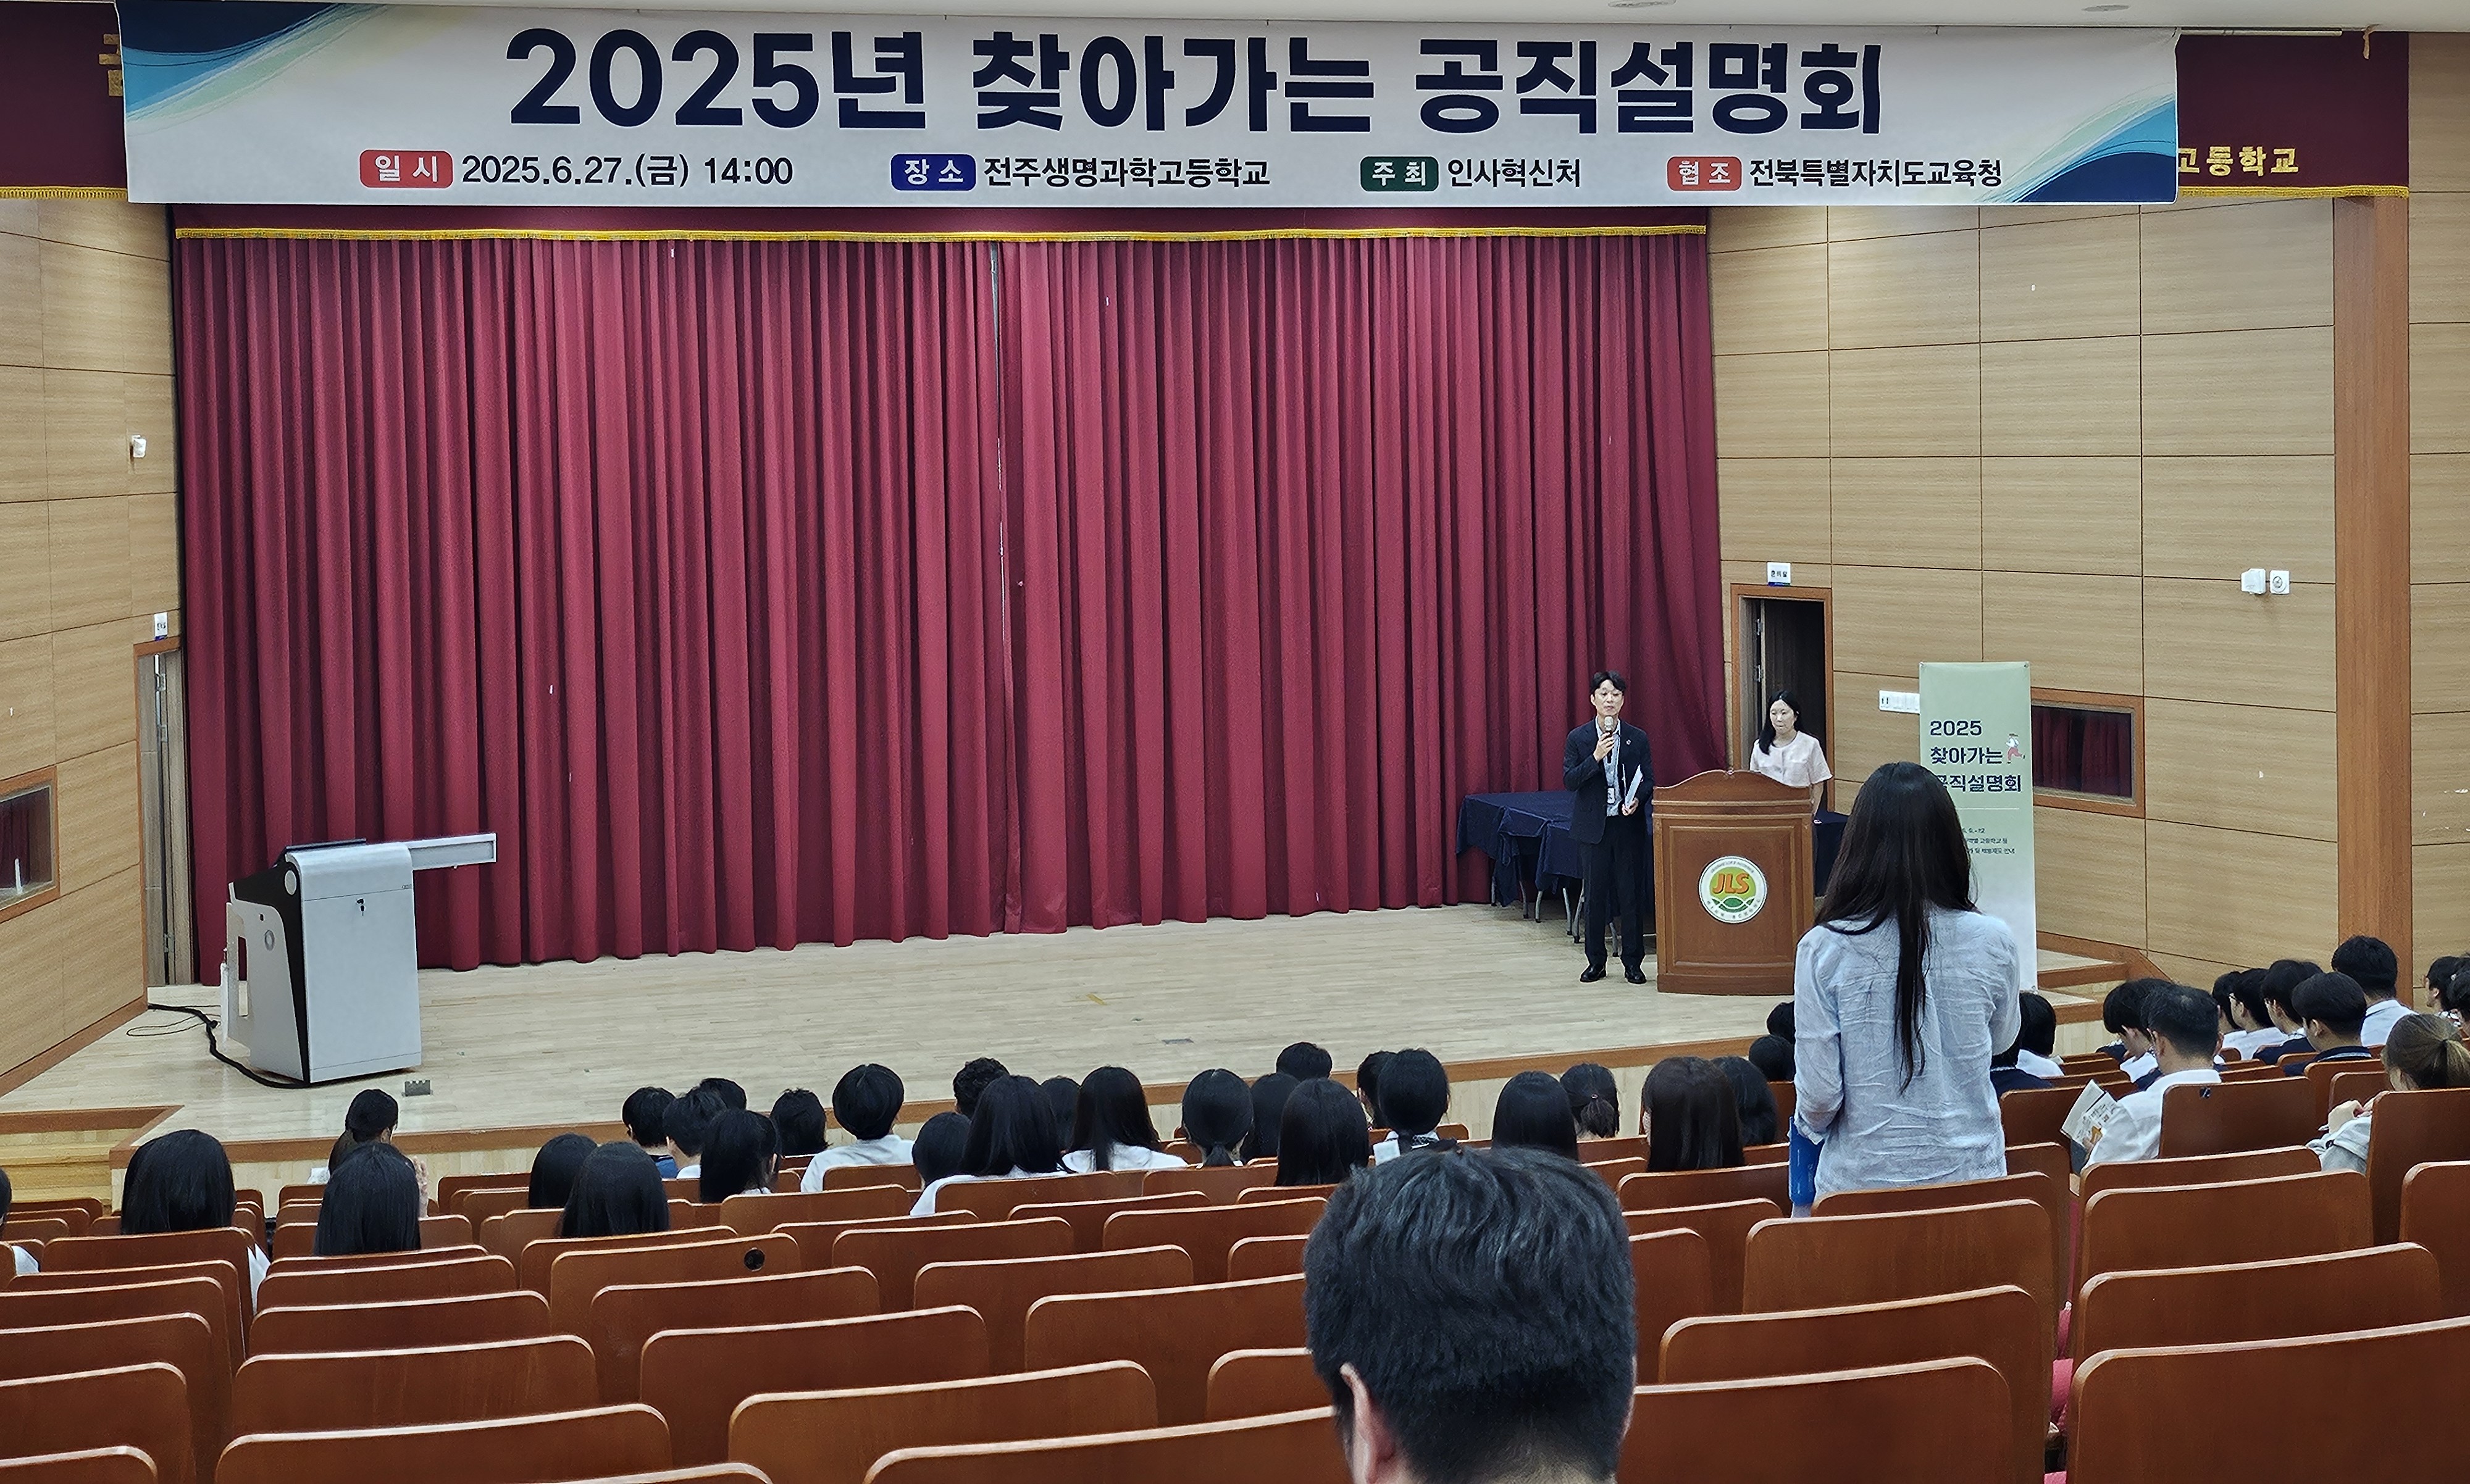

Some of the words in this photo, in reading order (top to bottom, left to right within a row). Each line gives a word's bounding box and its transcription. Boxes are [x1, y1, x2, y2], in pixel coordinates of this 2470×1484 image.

[507, 28, 926, 129] 2025년
[973, 31, 1374, 132] 찾아가는
[1415, 40, 1882, 134] 공직설명회
[462, 153, 689, 188] 2025.6.27.(금)
[705, 157, 793, 185] 14:00
[984, 157, 1270, 188] 전주생명과학고등학교
[1447, 159, 1580, 188] 인사혁신처
[1749, 159, 2002, 187] 전북특별자치도교육청
[2179, 146, 2299, 177] 고등학교
[1930, 720, 1982, 736] 2025
[1930, 746, 2003, 764] 찾아가는
[1712, 873, 1750, 894] JLS
